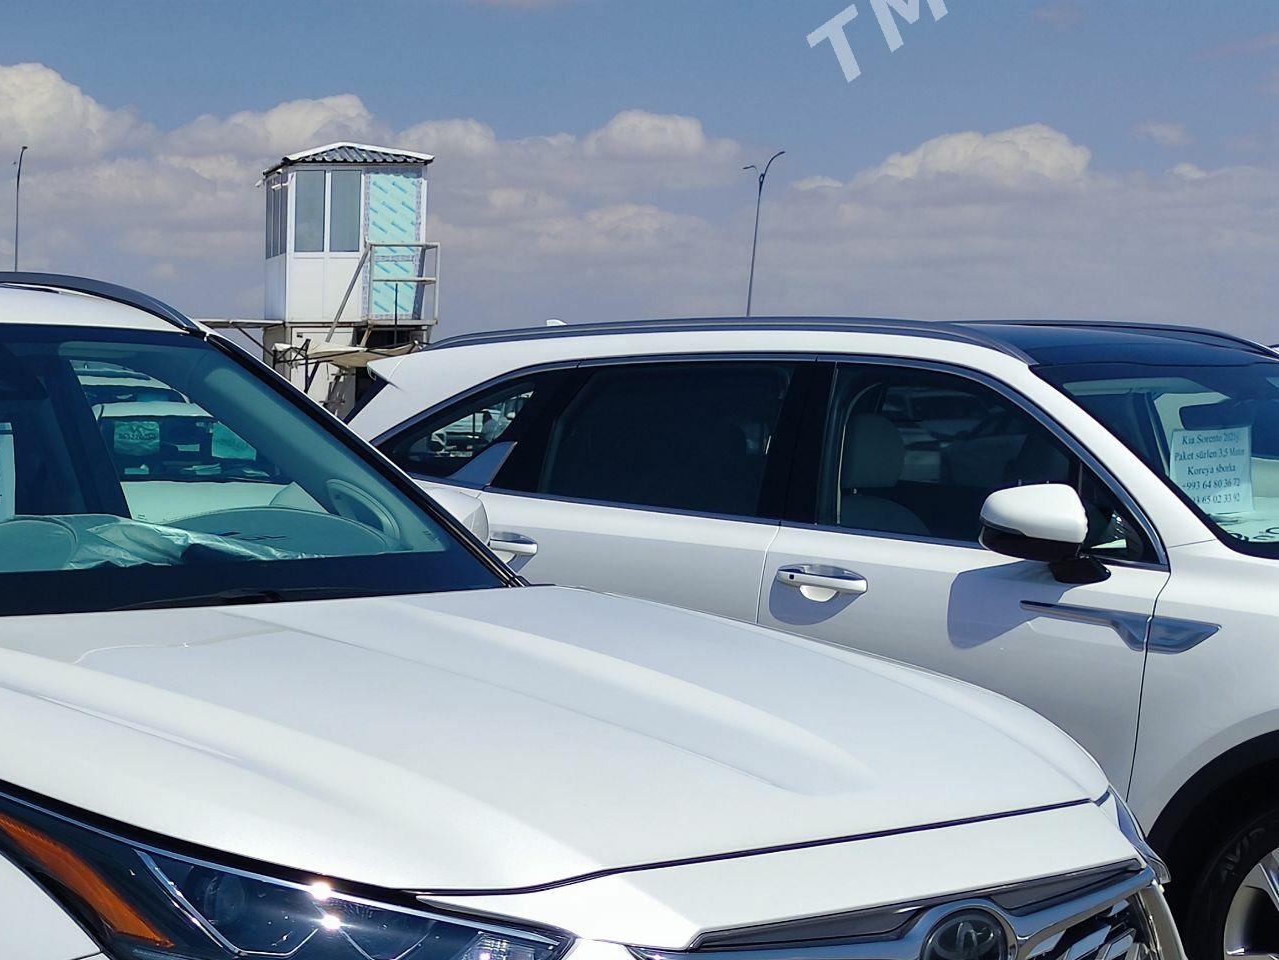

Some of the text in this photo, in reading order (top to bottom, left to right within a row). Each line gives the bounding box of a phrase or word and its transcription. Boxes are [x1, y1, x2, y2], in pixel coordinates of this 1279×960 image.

[1175, 451, 1194, 461] Paket
[1195, 449, 1217, 459] sürlen
[1187, 465, 1214, 477] Koreya
[1202, 480, 1212, 490] 64
